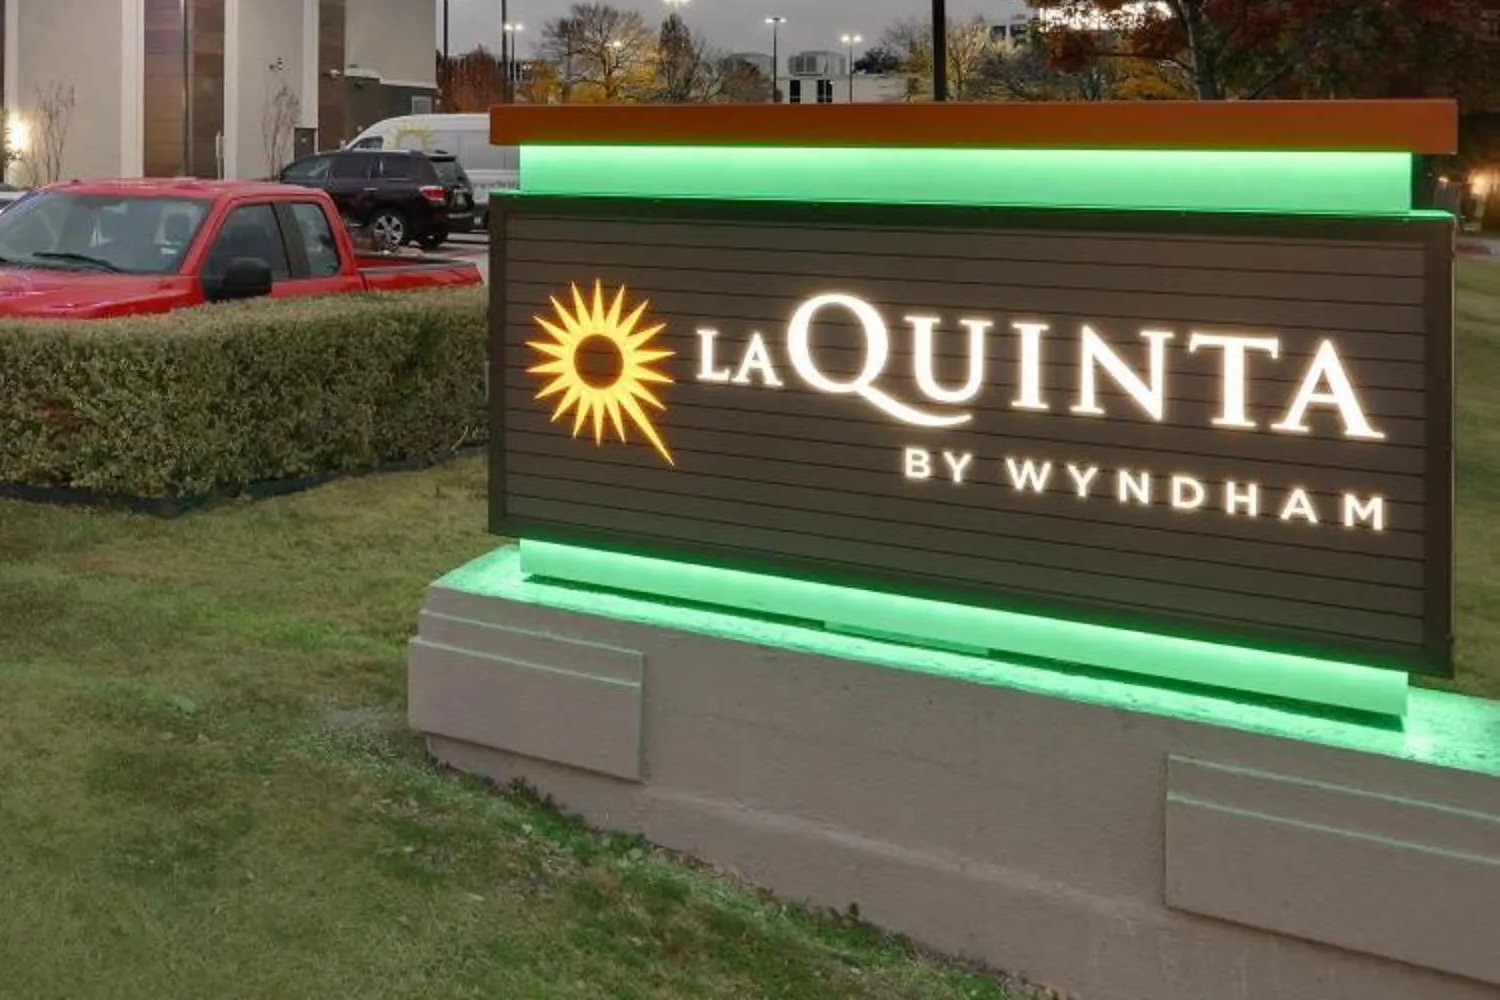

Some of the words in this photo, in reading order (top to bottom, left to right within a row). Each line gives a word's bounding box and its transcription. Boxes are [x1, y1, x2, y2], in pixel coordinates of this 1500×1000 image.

[695, 327, 784, 387] LA
[786, 292, 1386, 441] QUINTA
[903, 446, 972, 484] BY
[1005, 456, 1386, 532] WYNDHAM
